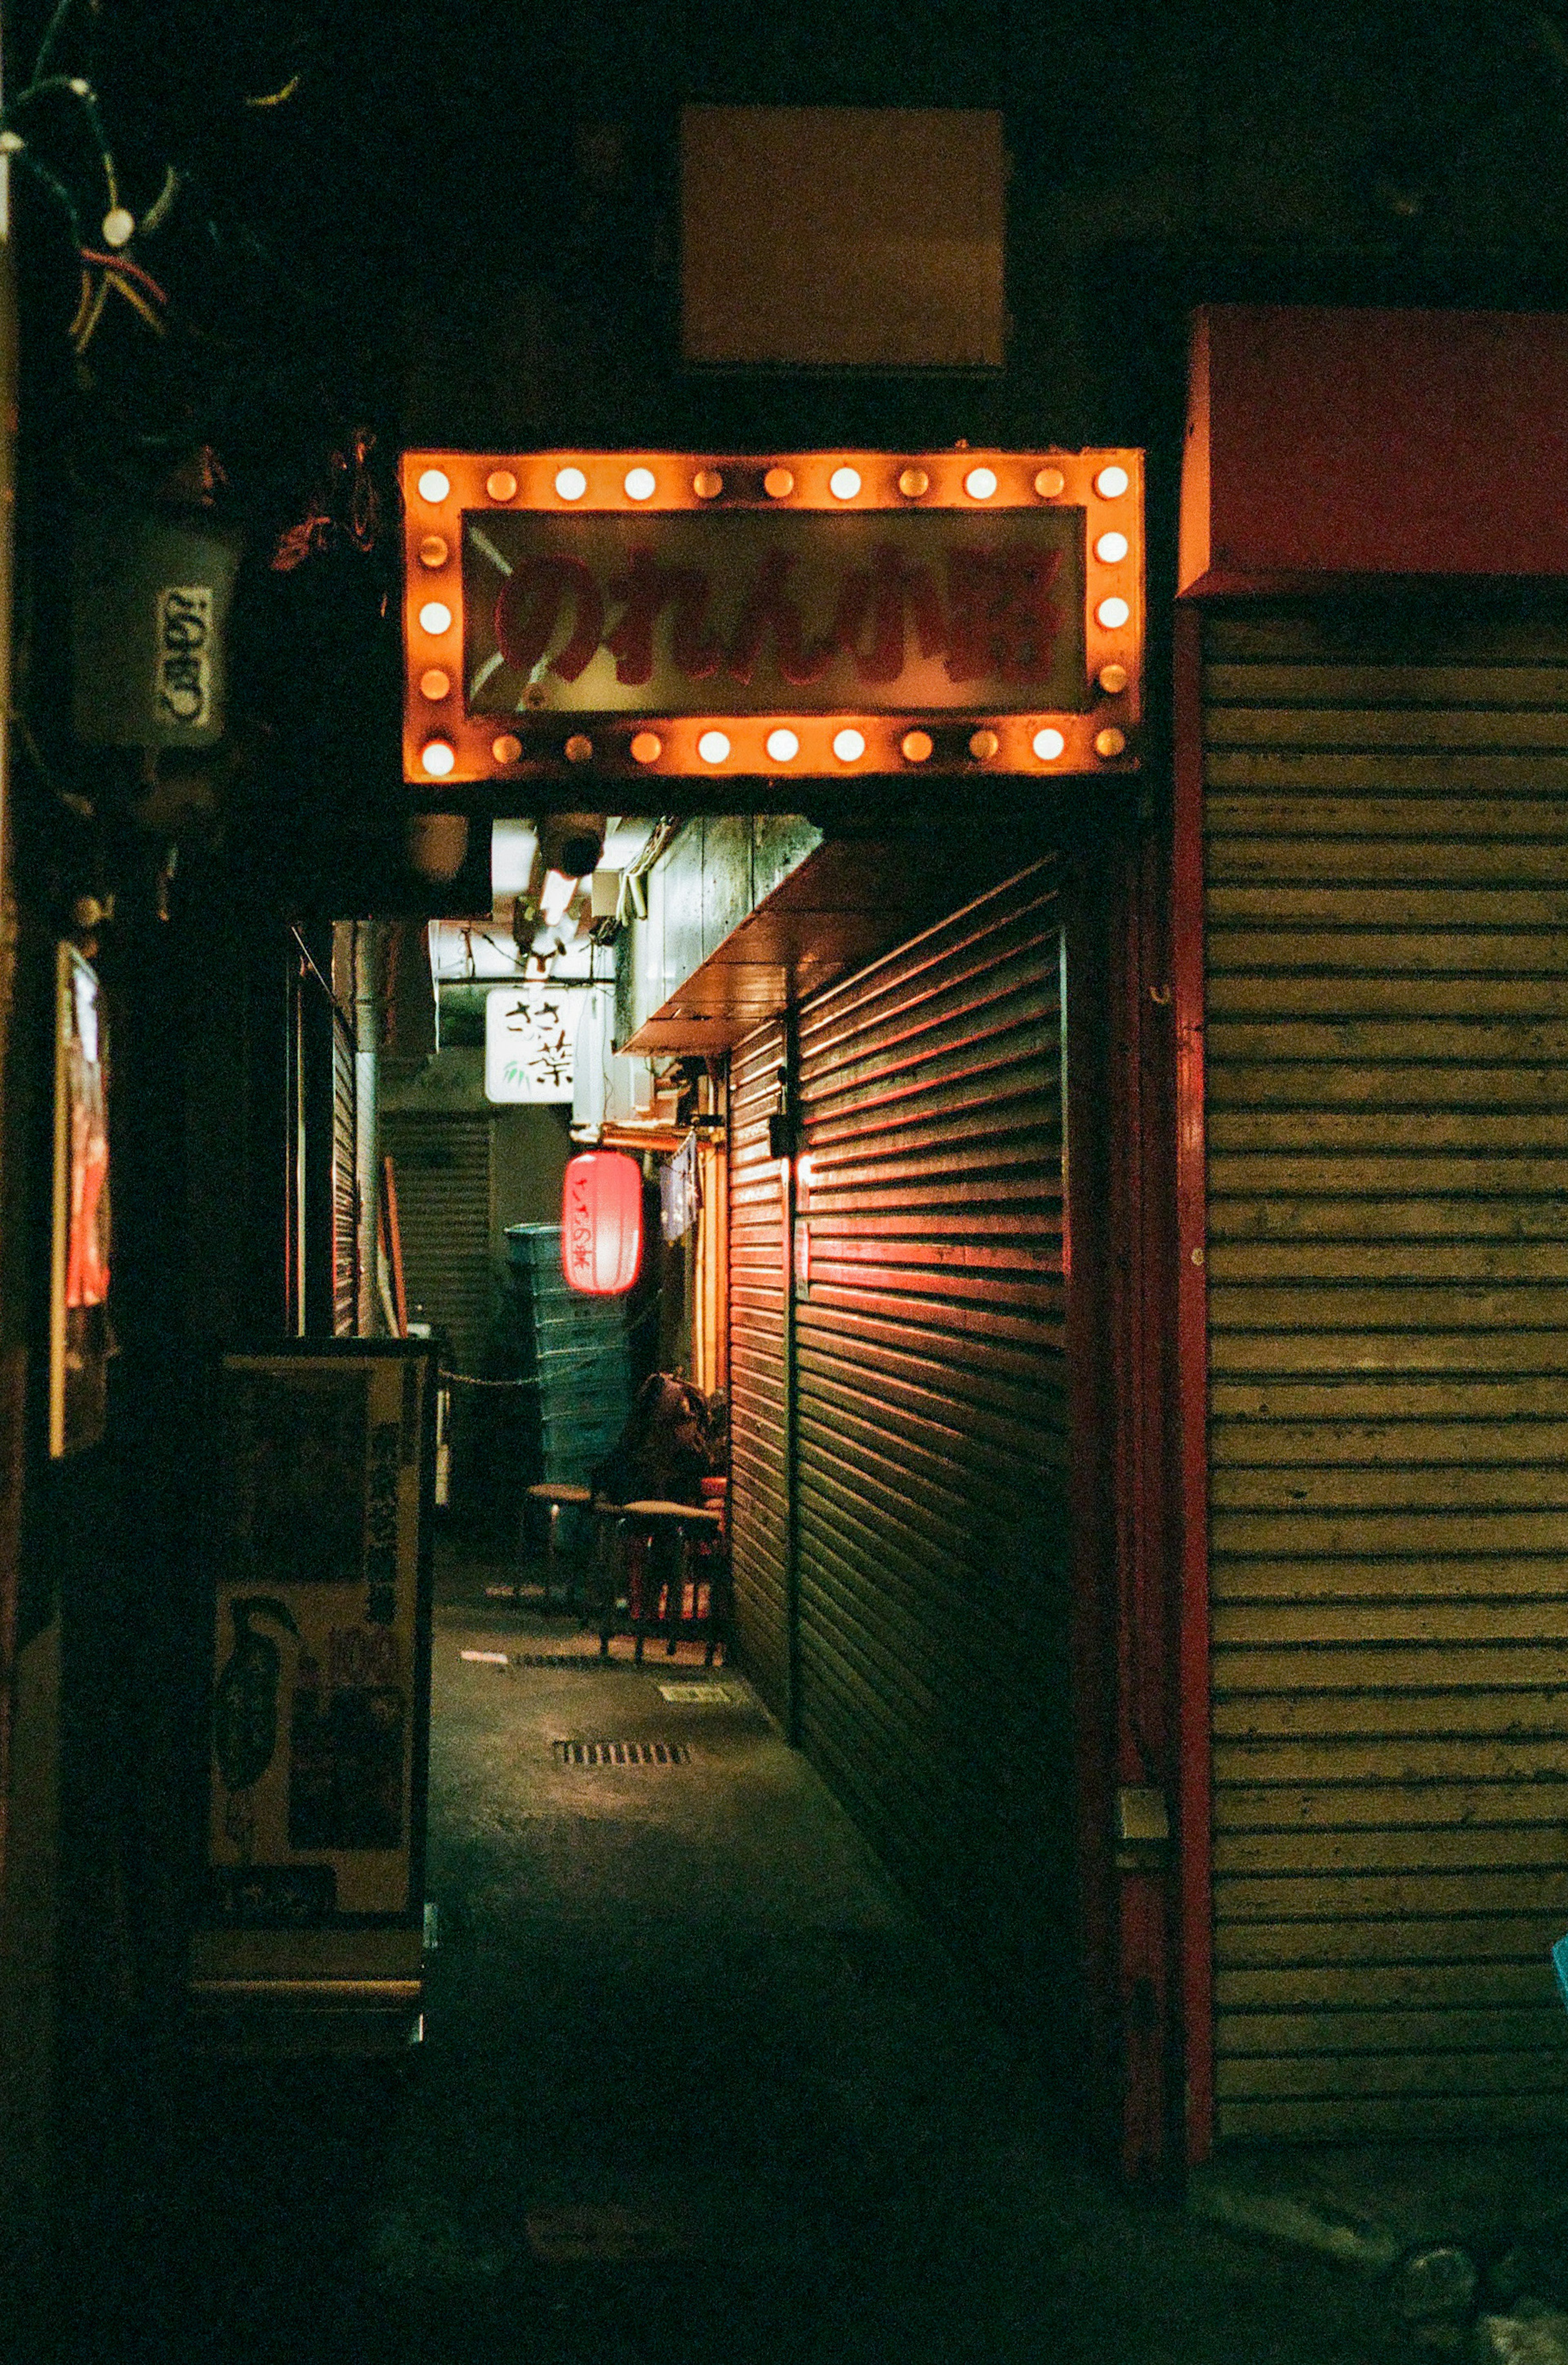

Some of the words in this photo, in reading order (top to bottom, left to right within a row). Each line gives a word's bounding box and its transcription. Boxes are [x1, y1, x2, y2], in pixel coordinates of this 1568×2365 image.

[494, 543, 1065, 686] のれん小路
[572, 1177, 594, 1269] ささの葉
